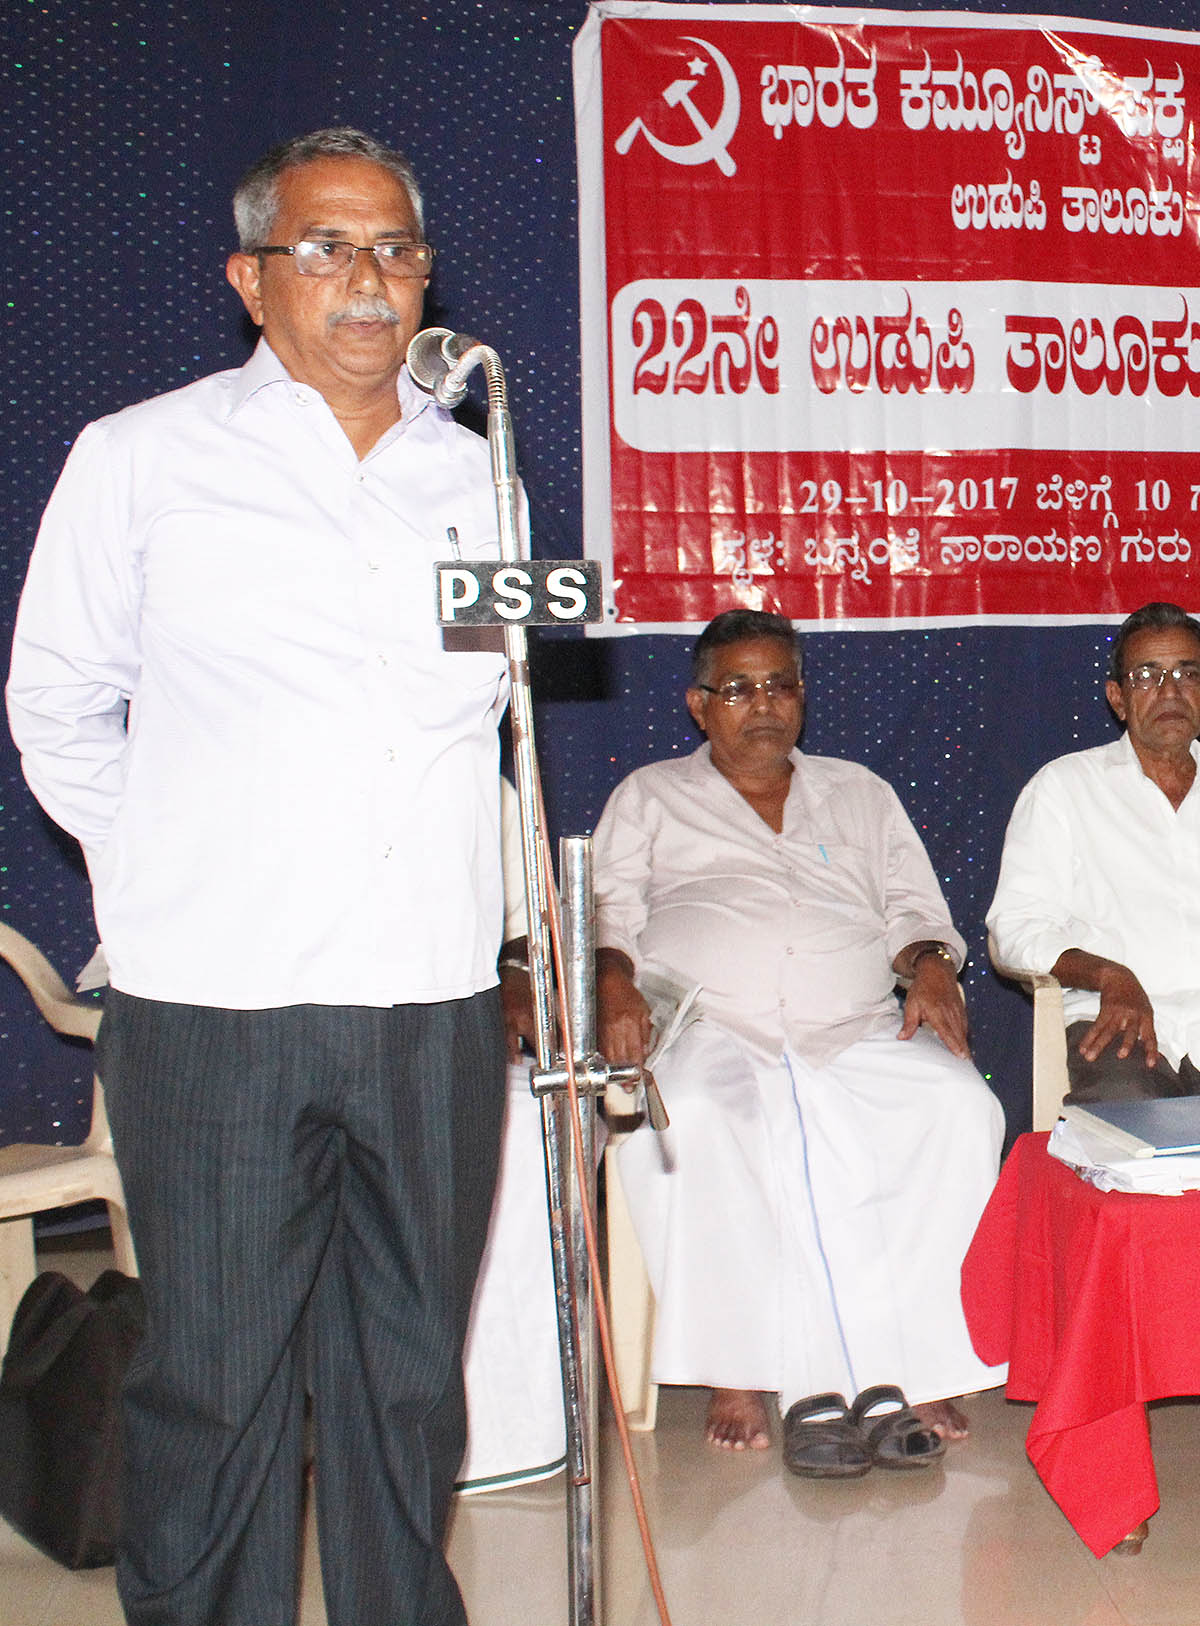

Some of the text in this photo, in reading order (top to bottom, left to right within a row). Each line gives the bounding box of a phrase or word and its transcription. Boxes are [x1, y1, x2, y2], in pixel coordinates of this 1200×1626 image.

[760, 34, 878, 140] ಭಾರತ
[951, 168, 1047, 231] ಉಡುಪಿ
[1061, 175, 1183, 237] ತಾಲೂಕು
[631, 285, 780, 396] 22ನೇ
[810, 286, 975, 394] ಉಡುಪಿ
[1036, 474, 1119, 529] ಬೆಳಿಗ್ಗೆ
[1134, 478, 1171, 511] 10
[803, 527, 921, 584] ಬನ್ನಂಜೆ
[940, 527, 1102, 564] ನಾರಾಯಣ
[1120, 528, 1192, 563] ಗುರು
[439, 567, 588, 621] PSS
